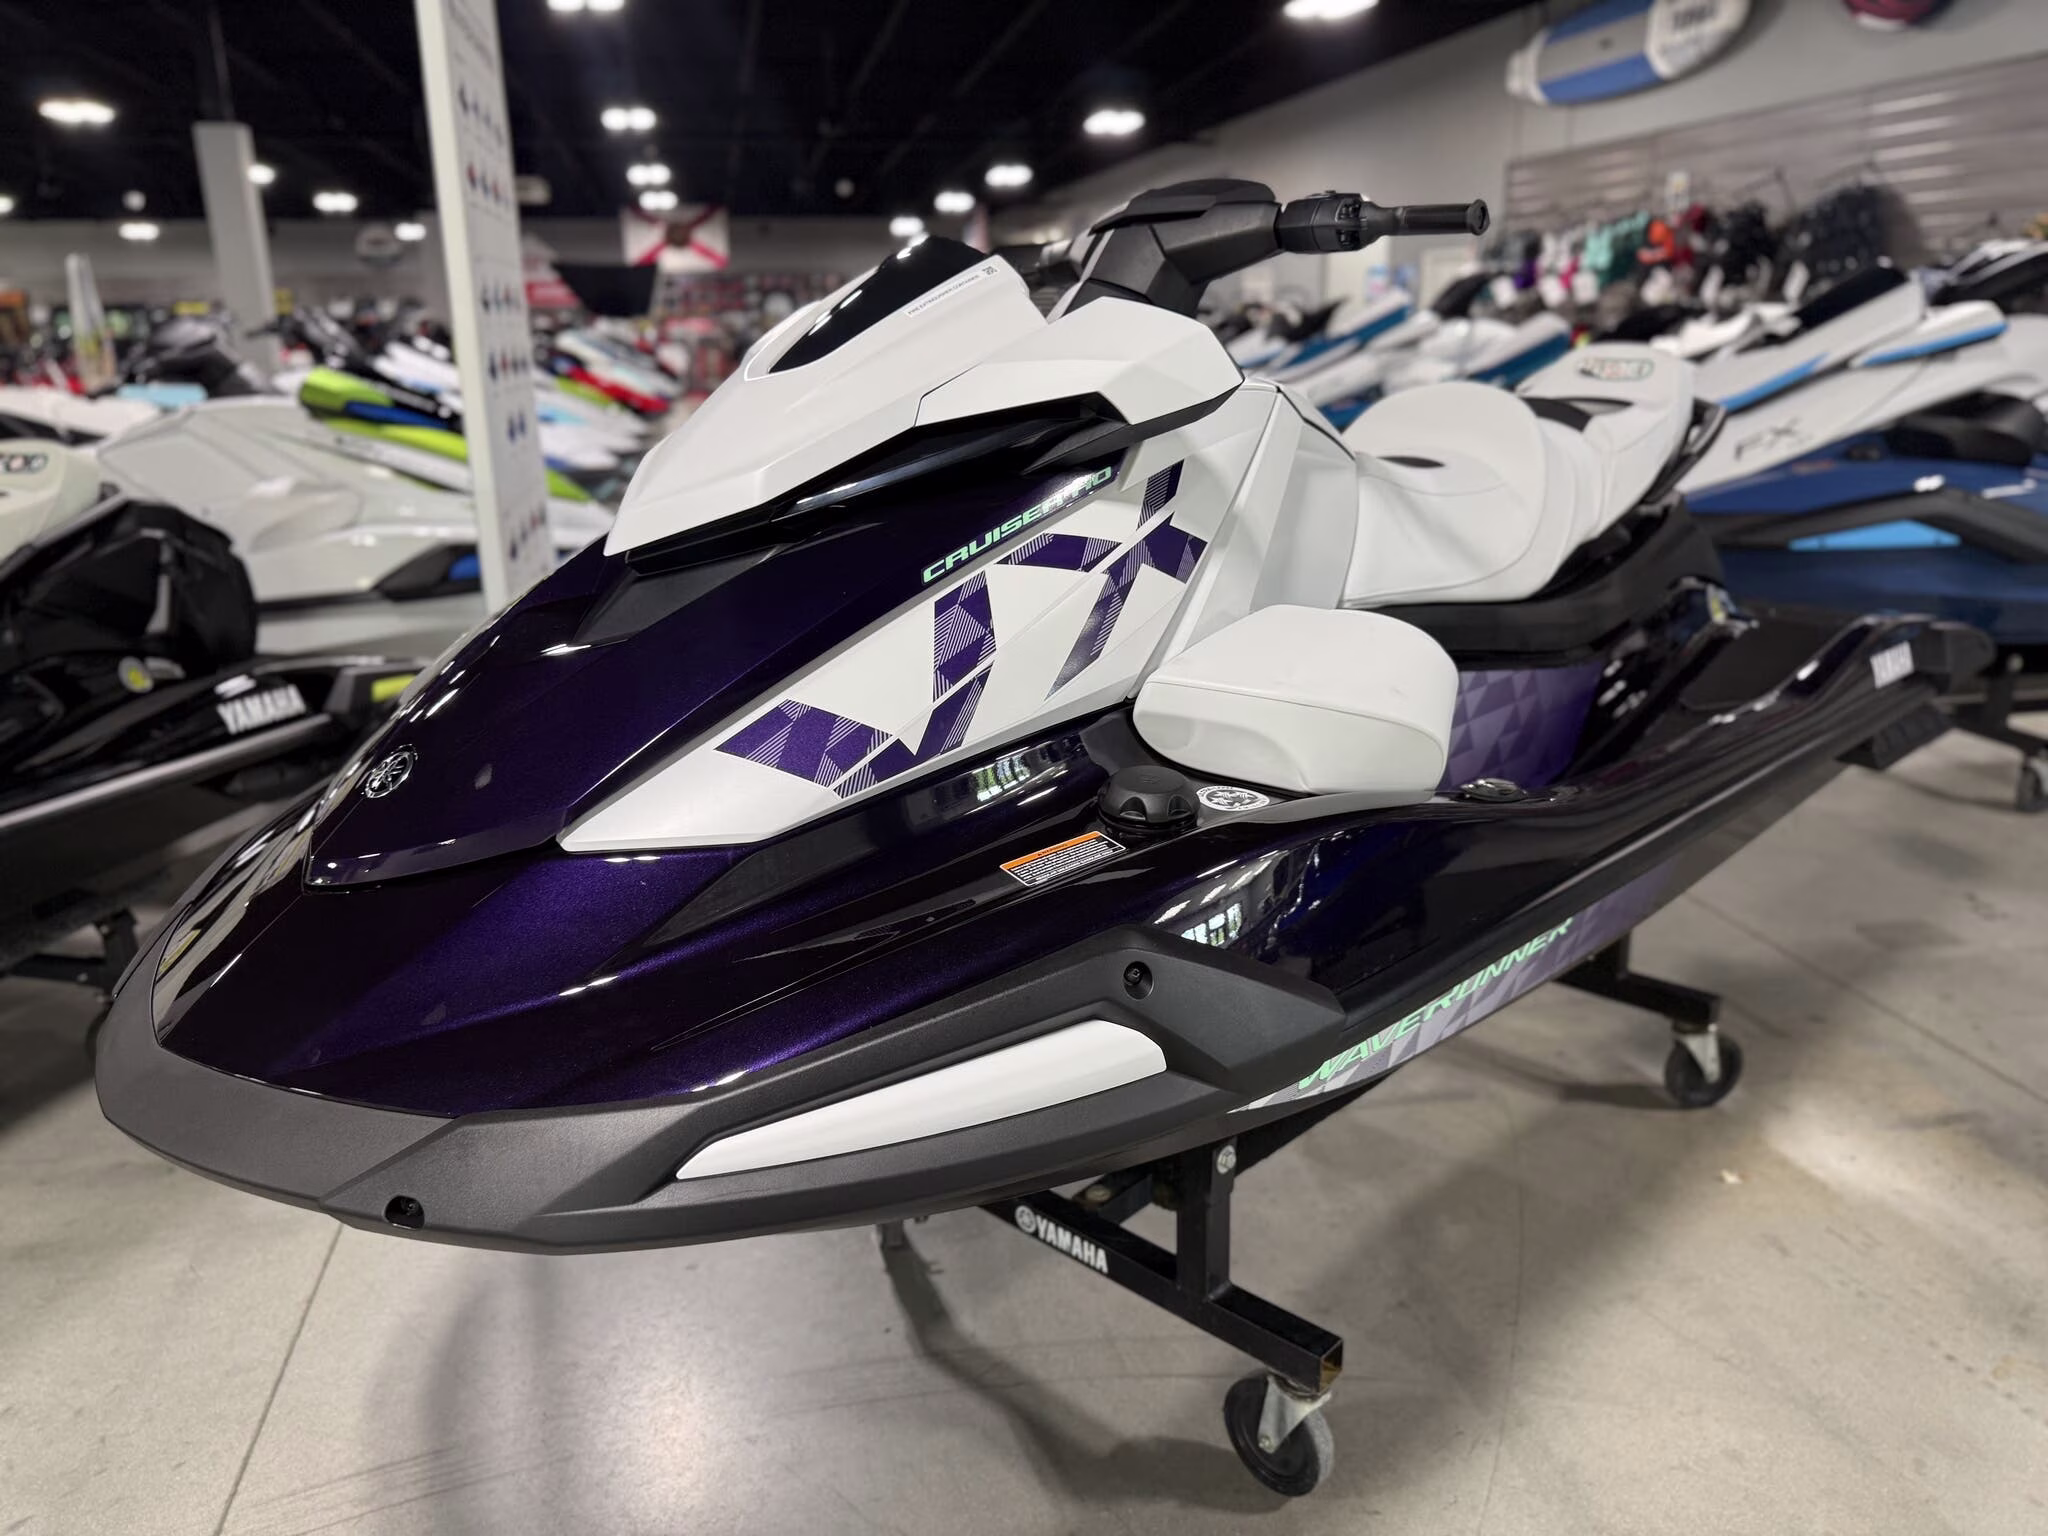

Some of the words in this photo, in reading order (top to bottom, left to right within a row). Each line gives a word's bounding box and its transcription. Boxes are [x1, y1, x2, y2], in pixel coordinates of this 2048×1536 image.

[923, 491, 1066, 583] CRUISER
[1298, 916, 1574, 1090] WAVERUNNER
[1036, 1214, 1108, 1274] YAMAHA
